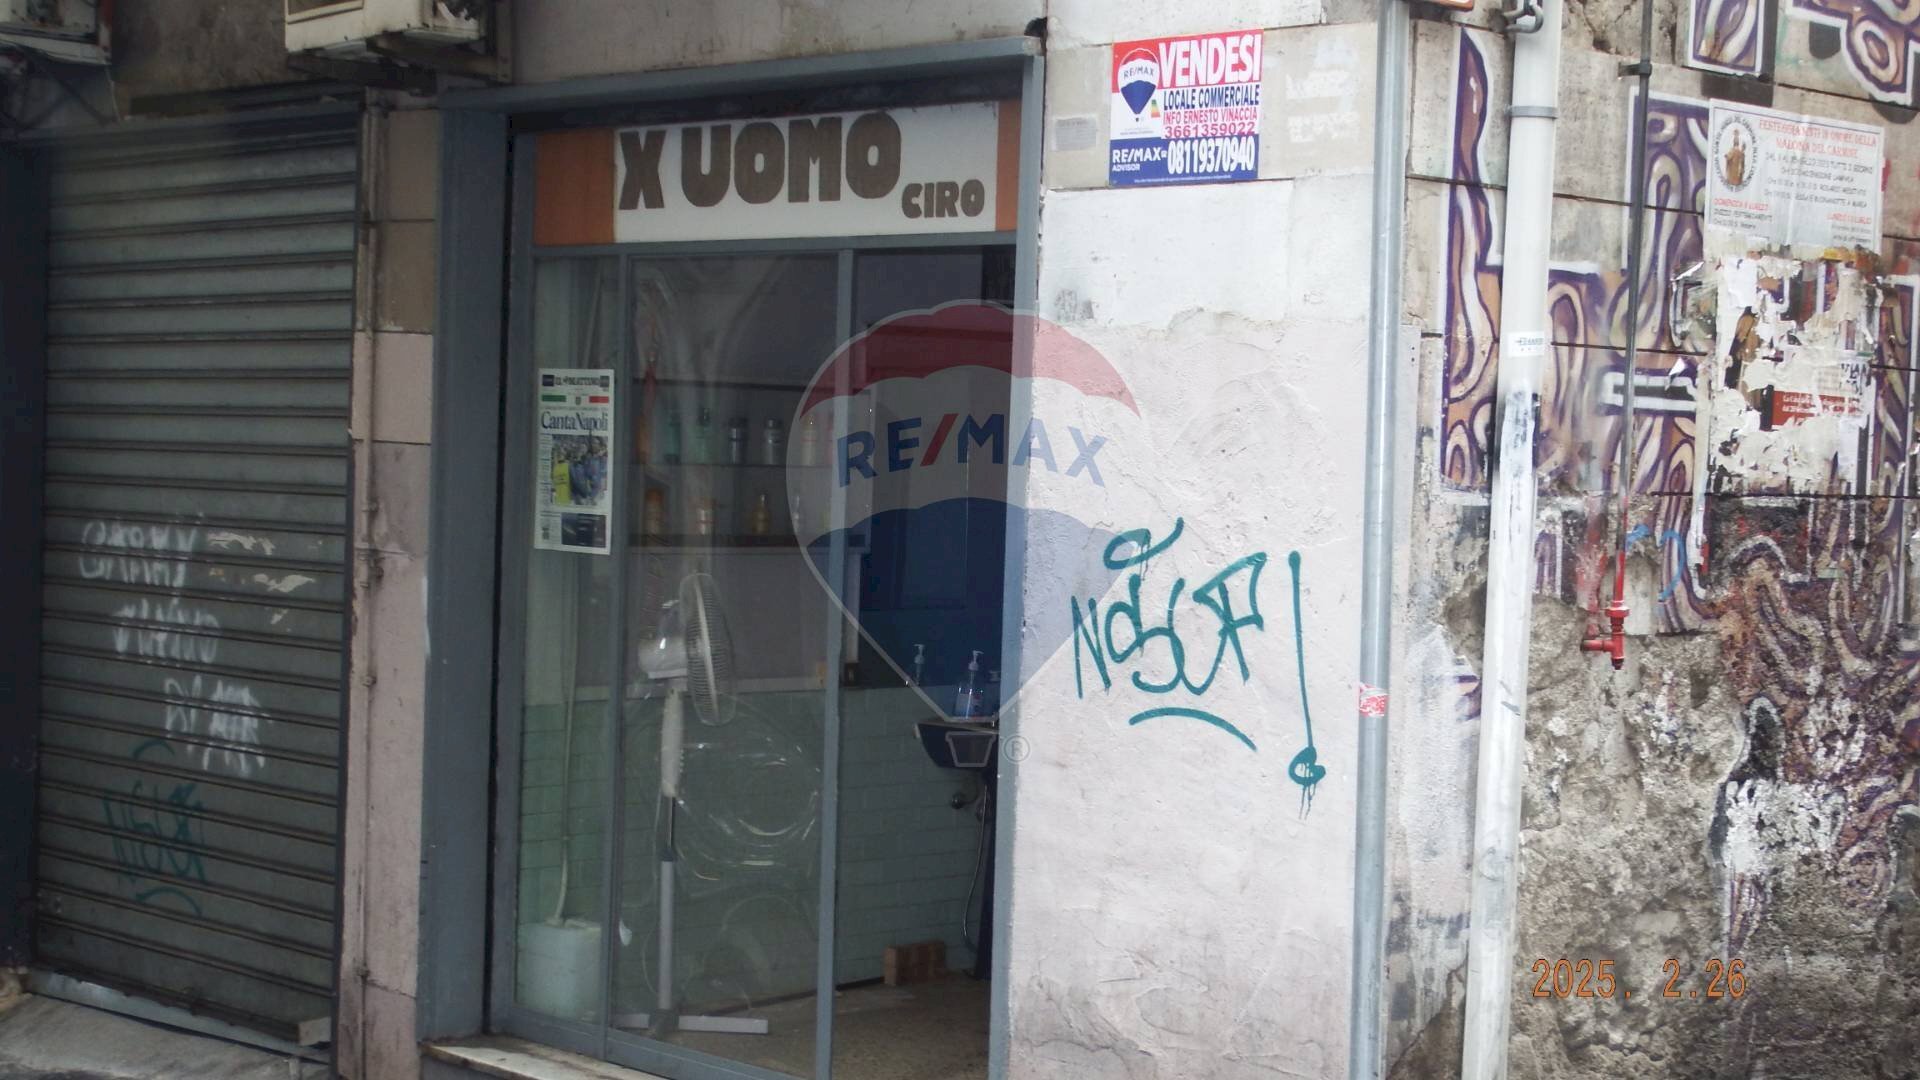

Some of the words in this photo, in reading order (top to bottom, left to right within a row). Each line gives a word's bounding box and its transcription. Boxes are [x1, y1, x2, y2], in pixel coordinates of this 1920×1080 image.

[1123, 66, 1155, 78] RE/MAX
[1158, 34, 1262, 88] VENDESI
[1163, 89, 1196, 111] LOCALE
[1198, 84, 1260, 109] COMMERCIALE
[1163, 110, 1181, 125] INFO
[1183, 109, 1218, 124] ERNESTO
[1220, 106, 1258, 123] VINACCIA
[1164, 122, 1255, 139] 3661359022
[618, 130, 667, 210] X
[680, 111, 901, 208] UOMO
[1112, 163, 1140, 172] ADVISOR
[1167, 136, 1256, 175] 08119370940
[901, 178, 985, 219] CIRO
